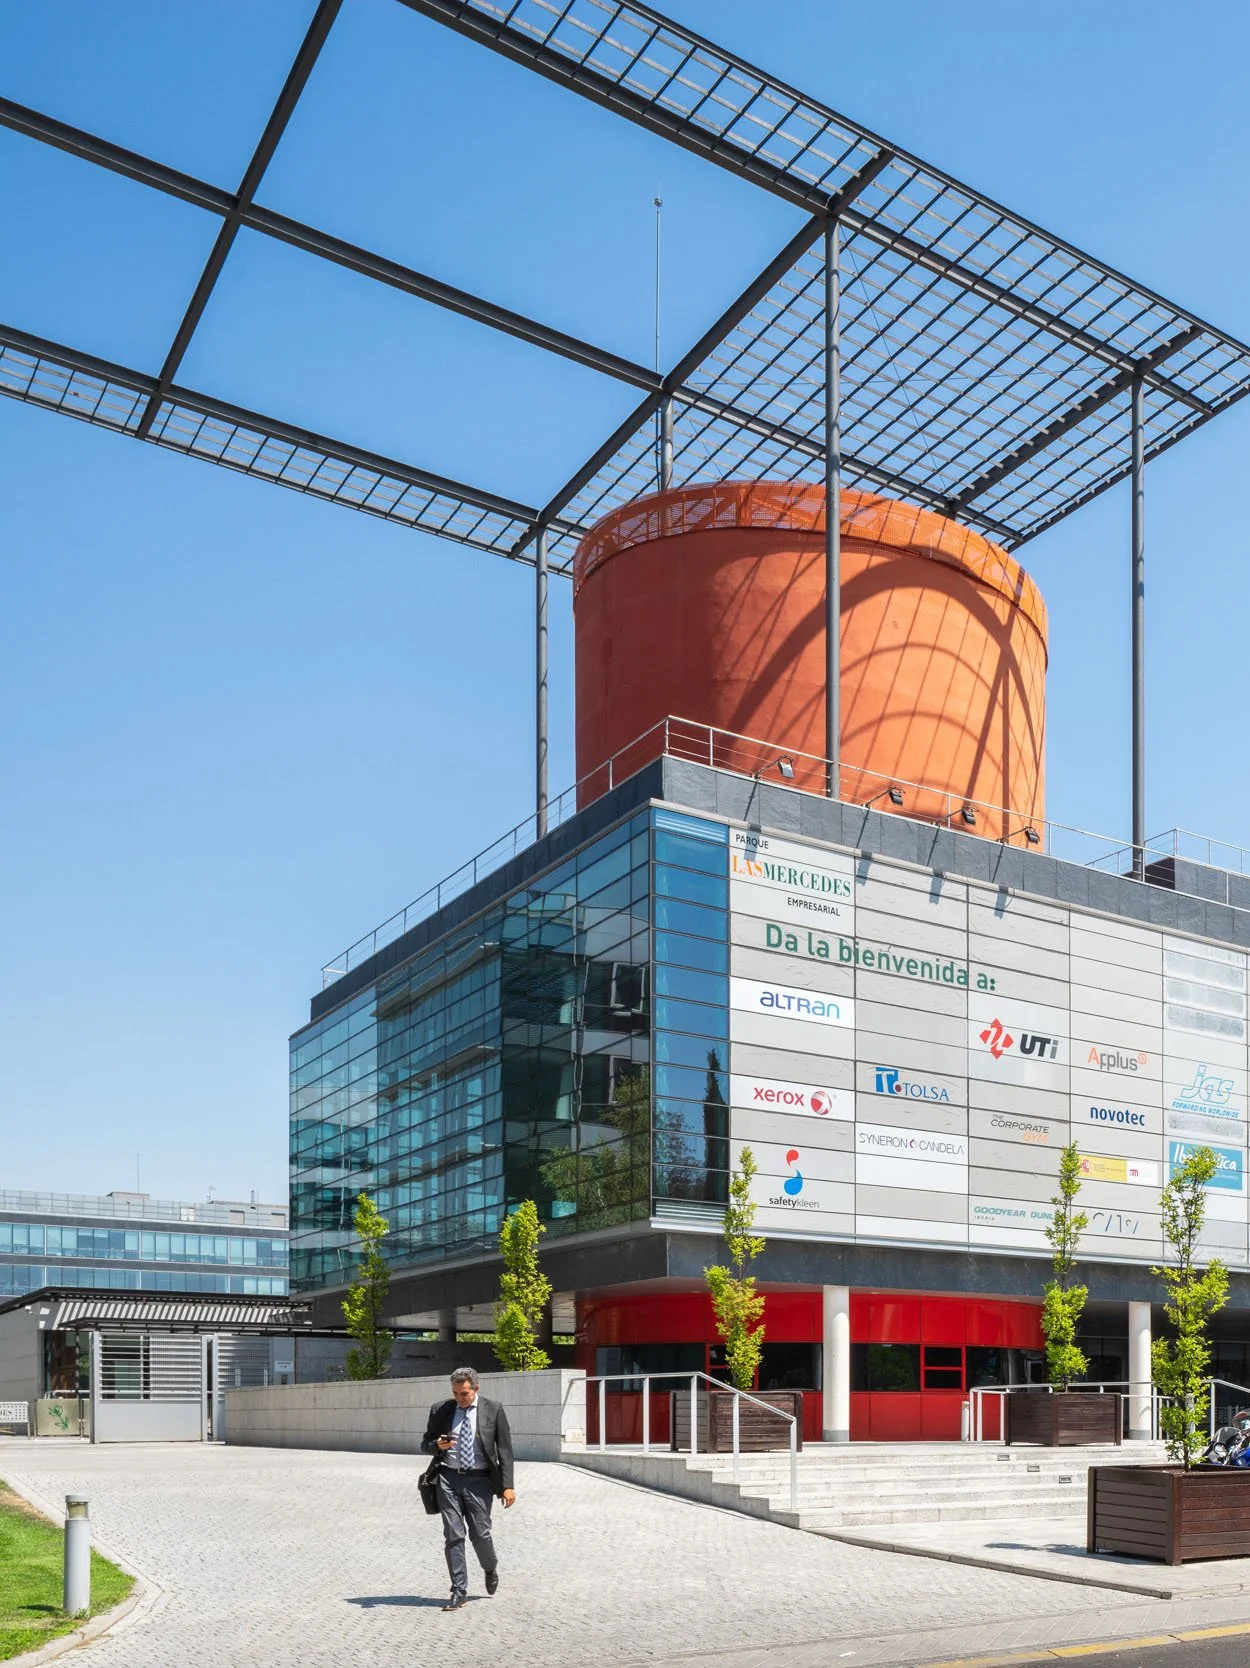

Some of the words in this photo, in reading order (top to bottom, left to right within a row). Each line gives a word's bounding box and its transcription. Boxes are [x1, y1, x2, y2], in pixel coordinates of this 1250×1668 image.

[735, 833, 769, 849] PARQUE
[787, 897, 841, 917] EMPRESARIAL
[765, 923, 798, 953] Da
[807, 932, 830, 959] la
[839, 937, 969, 986] bienvenida
[977, 972, 996, 991] a:
[1088, 1047, 1138, 1072] Applus
[753, 1086, 805, 1107] xerox
[903, 1082, 949, 1102] TOLSA
[1090, 1106, 1145, 1127] novotec
[1172, 1101, 1206, 1114] FORWARDING
[1207, 1107, 1240, 1119] WORLDWIDE
[990, 1119, 1050, 1134] CORPORATE
[859, 1132, 908, 1149] SYNERON
[919, 1140, 964, 1155] CANDELA
[1023, 1132, 1049, 1144] GYM
[769, 1196, 820, 1210] safetykleen
[974, 1206, 1026, 1218] GOODYEAR
[1030, 1211, 1056, 1221] DUNL
